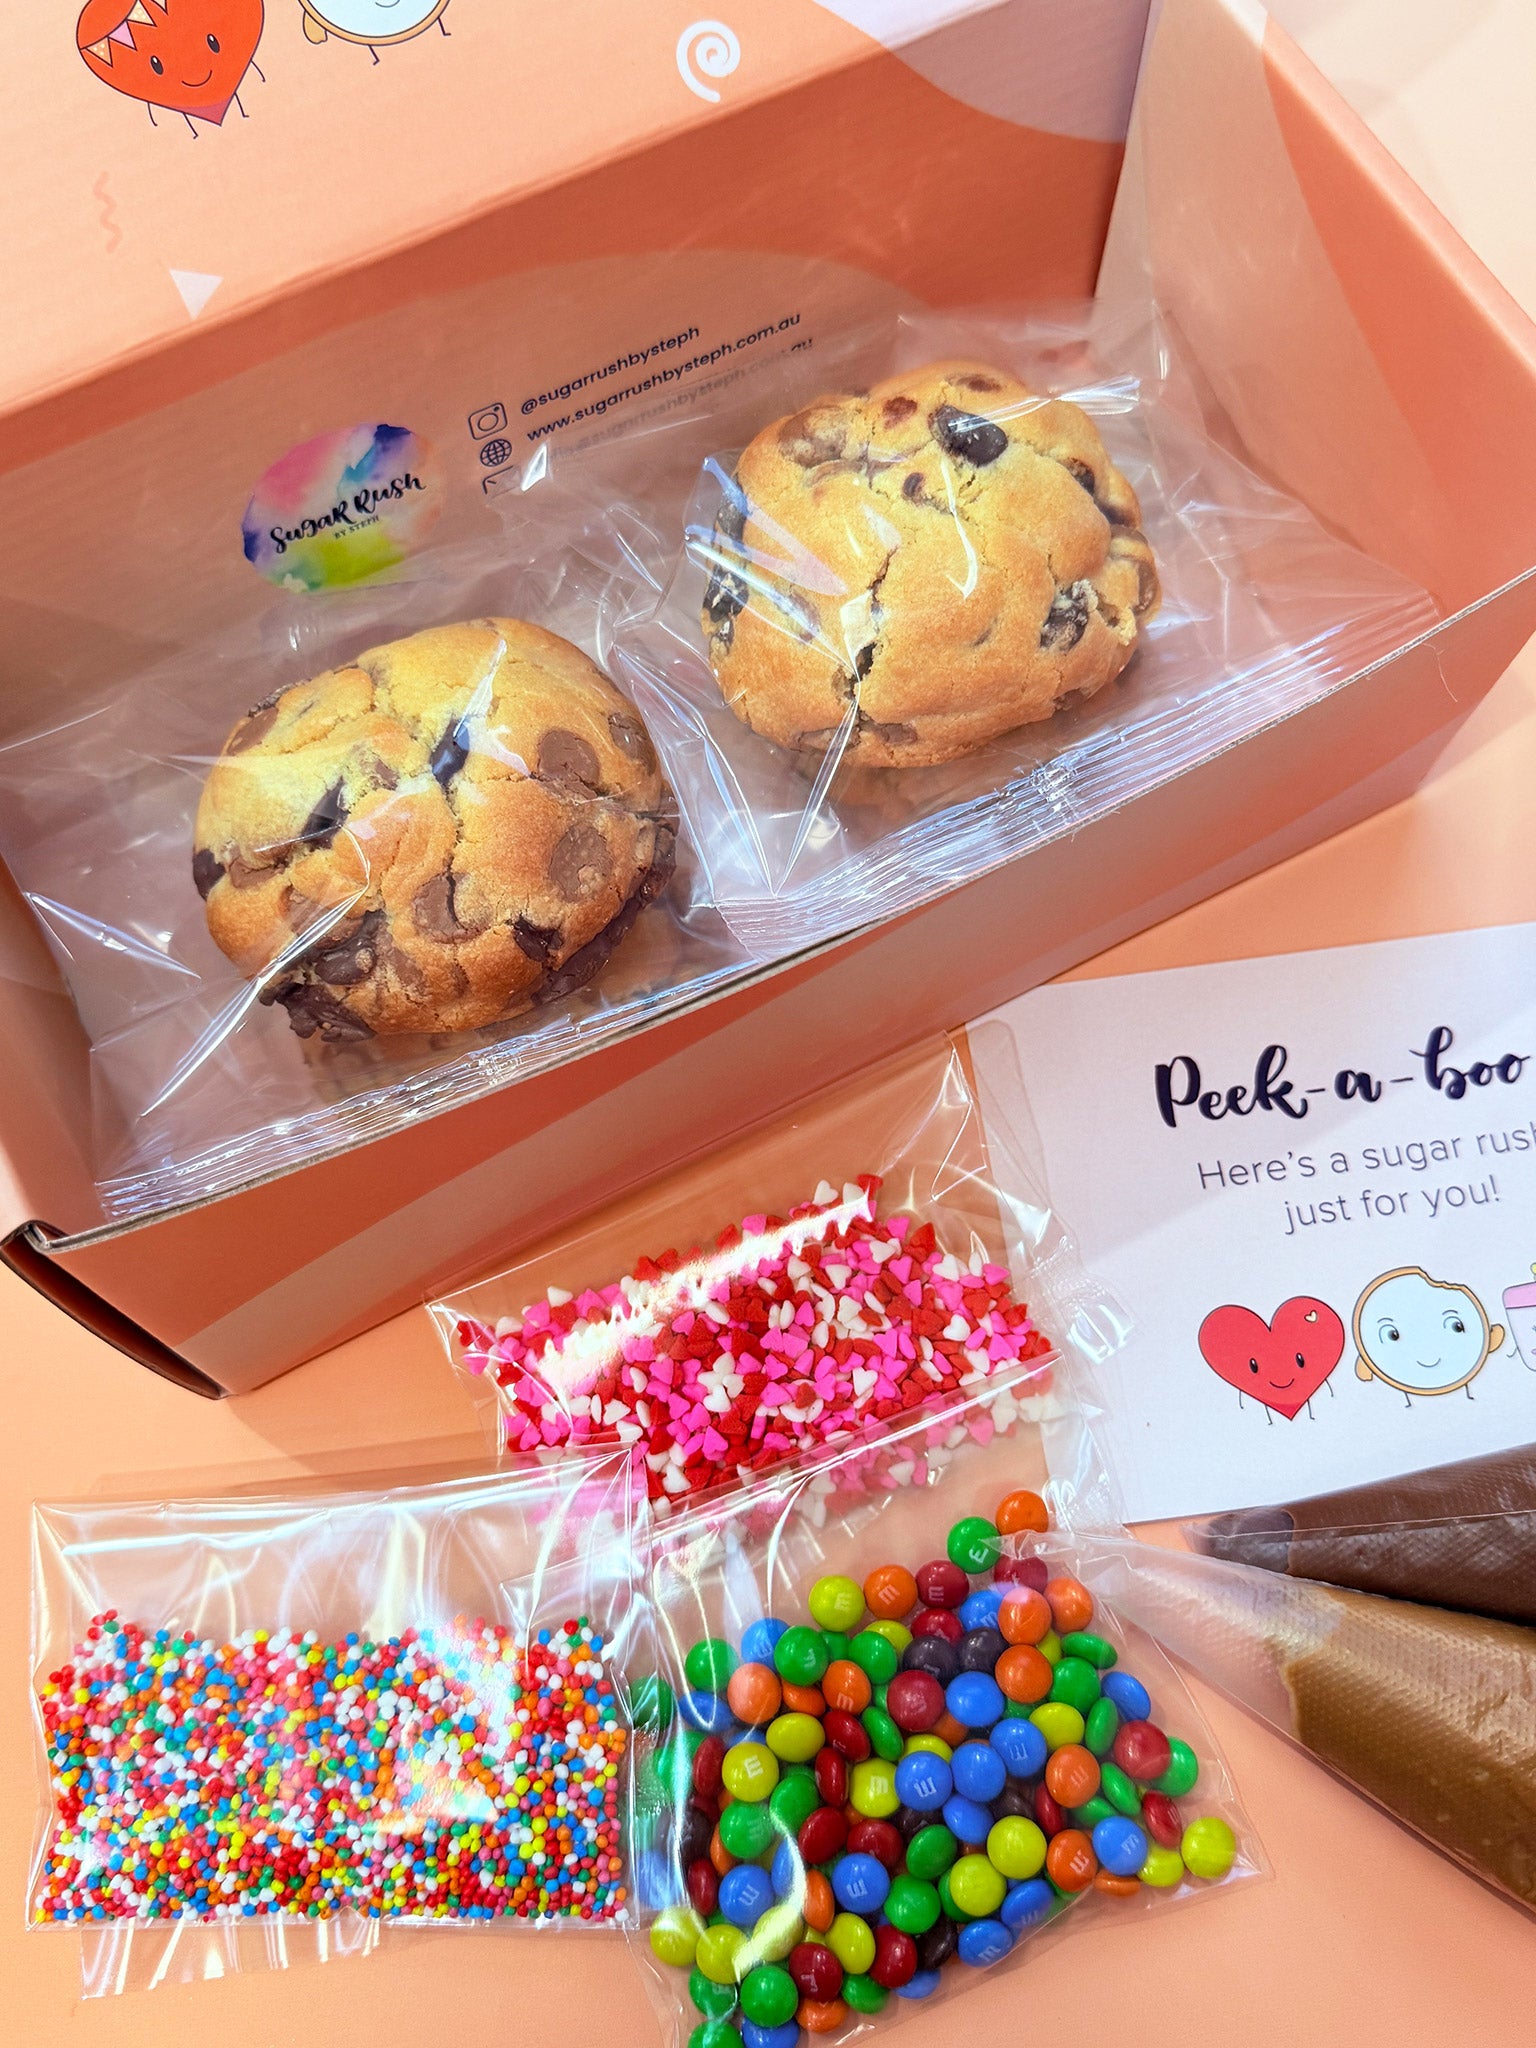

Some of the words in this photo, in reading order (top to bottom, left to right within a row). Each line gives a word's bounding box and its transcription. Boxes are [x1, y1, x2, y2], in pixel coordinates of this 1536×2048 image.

[520, 326, 700, 416] @sugarrushbysteph
[526, 313, 801, 442] www.sugarrushbysteph.com.au
[1197, 1151, 1317, 1190] Here's
[1330, 1151, 1350, 1174] a
[1362, 1137, 1461, 1172] sugar
[1284, 1195, 1352, 1236] just
[1359, 1188, 1409, 1218] for
[1420, 1174, 1501, 1218] you!
